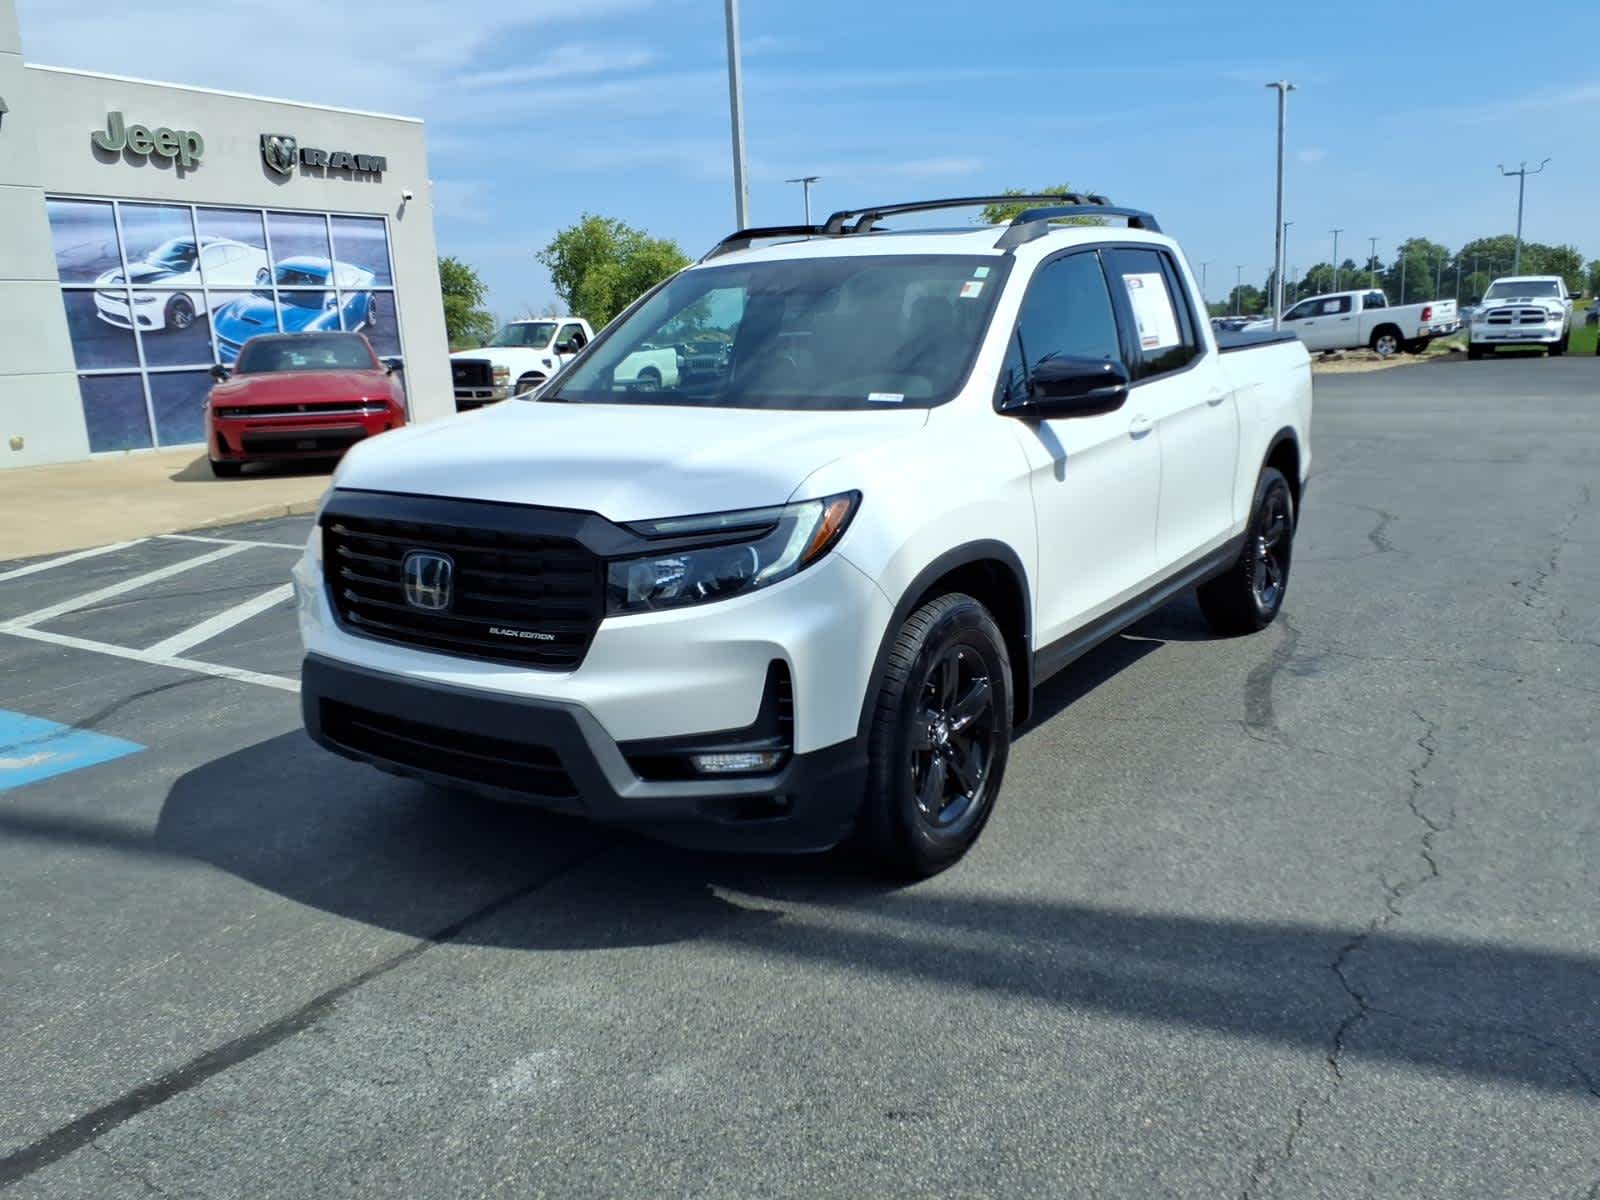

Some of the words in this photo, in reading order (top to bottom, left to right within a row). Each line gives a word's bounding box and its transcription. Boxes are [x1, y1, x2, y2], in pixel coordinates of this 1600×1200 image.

[91, 111, 205, 167] Jeep
[300, 147, 388, 173] RAM
[489, 626, 519, 637] BLACK
[520, 630, 556, 641] EDITION
